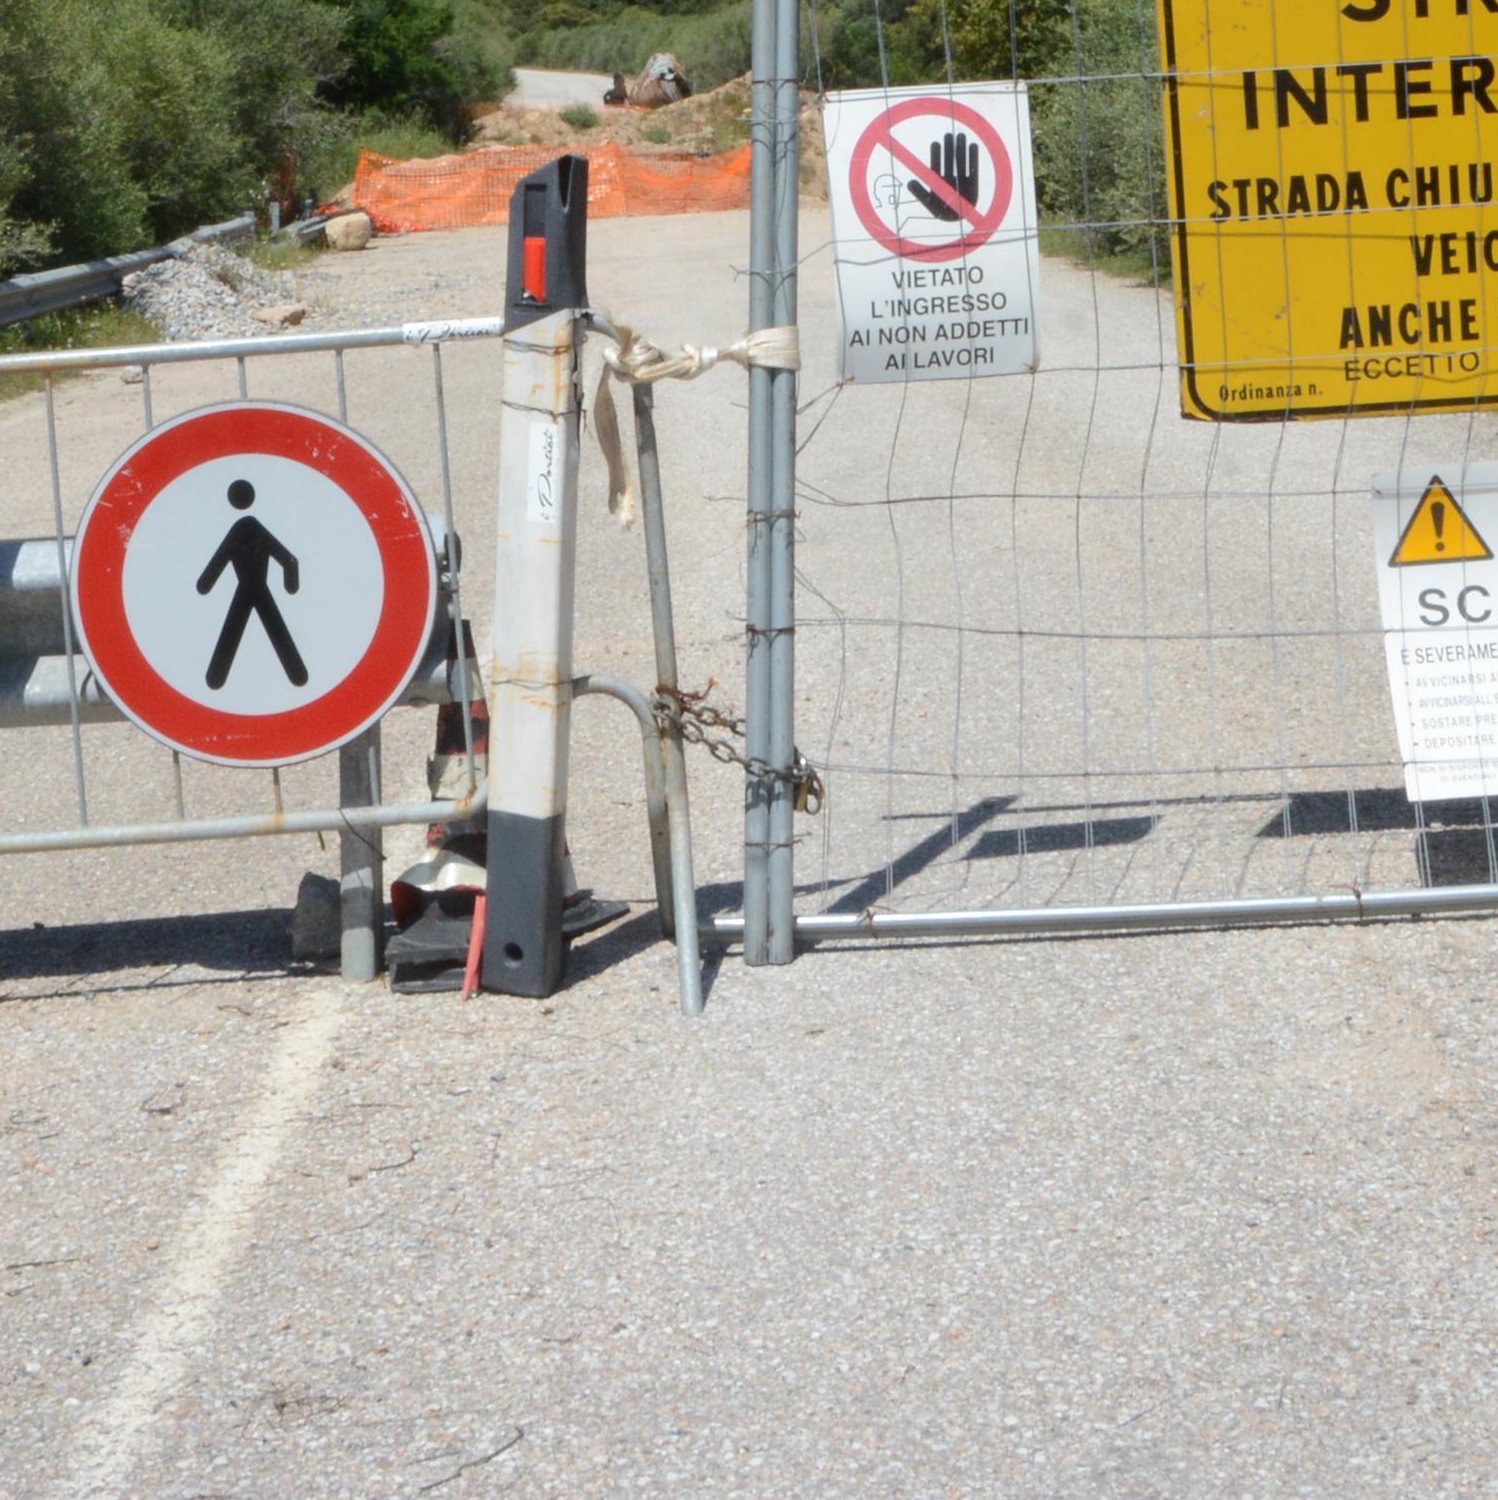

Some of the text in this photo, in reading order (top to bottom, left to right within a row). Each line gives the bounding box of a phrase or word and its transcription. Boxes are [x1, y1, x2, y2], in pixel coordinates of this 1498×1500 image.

[1207, 171, 1369, 223] STRADA
[892, 266, 983, 288] VIETATO
[871, 293, 1007, 319] L'INGRESSO
[850, 319, 1029, 346] AI NON ADDETTI
[1340, 300, 1479, 349] ANCHE
[885, 348, 994, 370] AI LAVORI
[1218, 383, 1324, 402] Ordinanza n.
[1421, 714, 1473, 730] SOSTARE
[1423, 733, 1495, 750] DEPOSITARE
